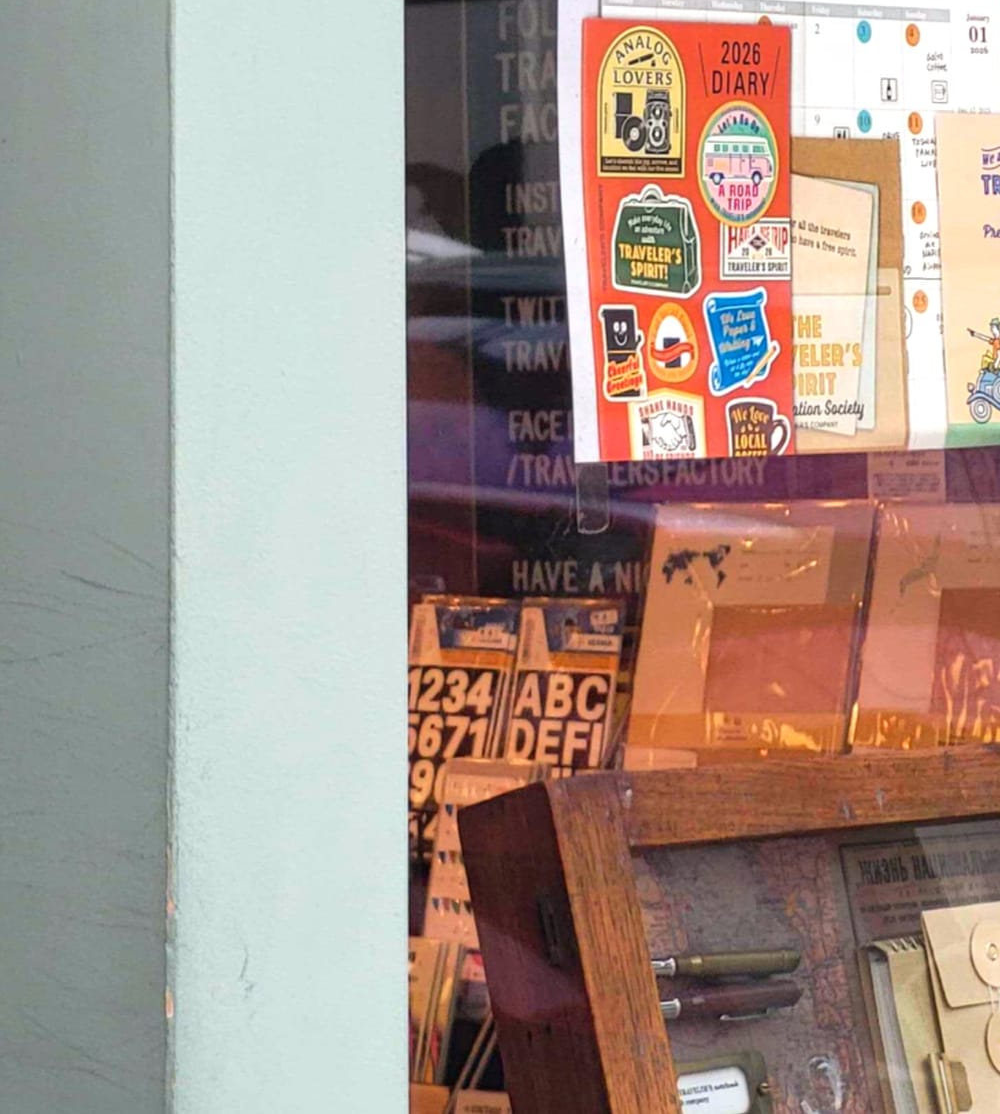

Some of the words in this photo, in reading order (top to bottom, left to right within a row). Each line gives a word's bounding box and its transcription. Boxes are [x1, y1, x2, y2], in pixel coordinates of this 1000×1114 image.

[966, 14, 990, 23] January
[969, 26, 987, 43] 01
[614, 35, 673, 66] ANALOG
[721, 41, 761, 65] 2026
[613, 70, 673, 86] LOVERS
[712, 70, 769, 96] DIARY
[718, 184, 725, 197] A
[729, 184, 759, 197] ROAD
[727, 198, 752, 211] TRIP
[618, 243, 682, 265] TRAVELER'S
[630, 261, 669, 280] SPIRIT!
[728, 261, 766, 273] TRAVELER'S
[768, 262, 789, 272] SPIRIT
[732, 407, 748, 423] We
[824, 399, 864, 421] Society
[735, 433, 767, 450] LOCAL
[512, 560, 578, 592] HAVE
[589, 562, 604, 592] A
[408, 668, 494, 715] 1234
[515, 673, 608, 721] ABC
